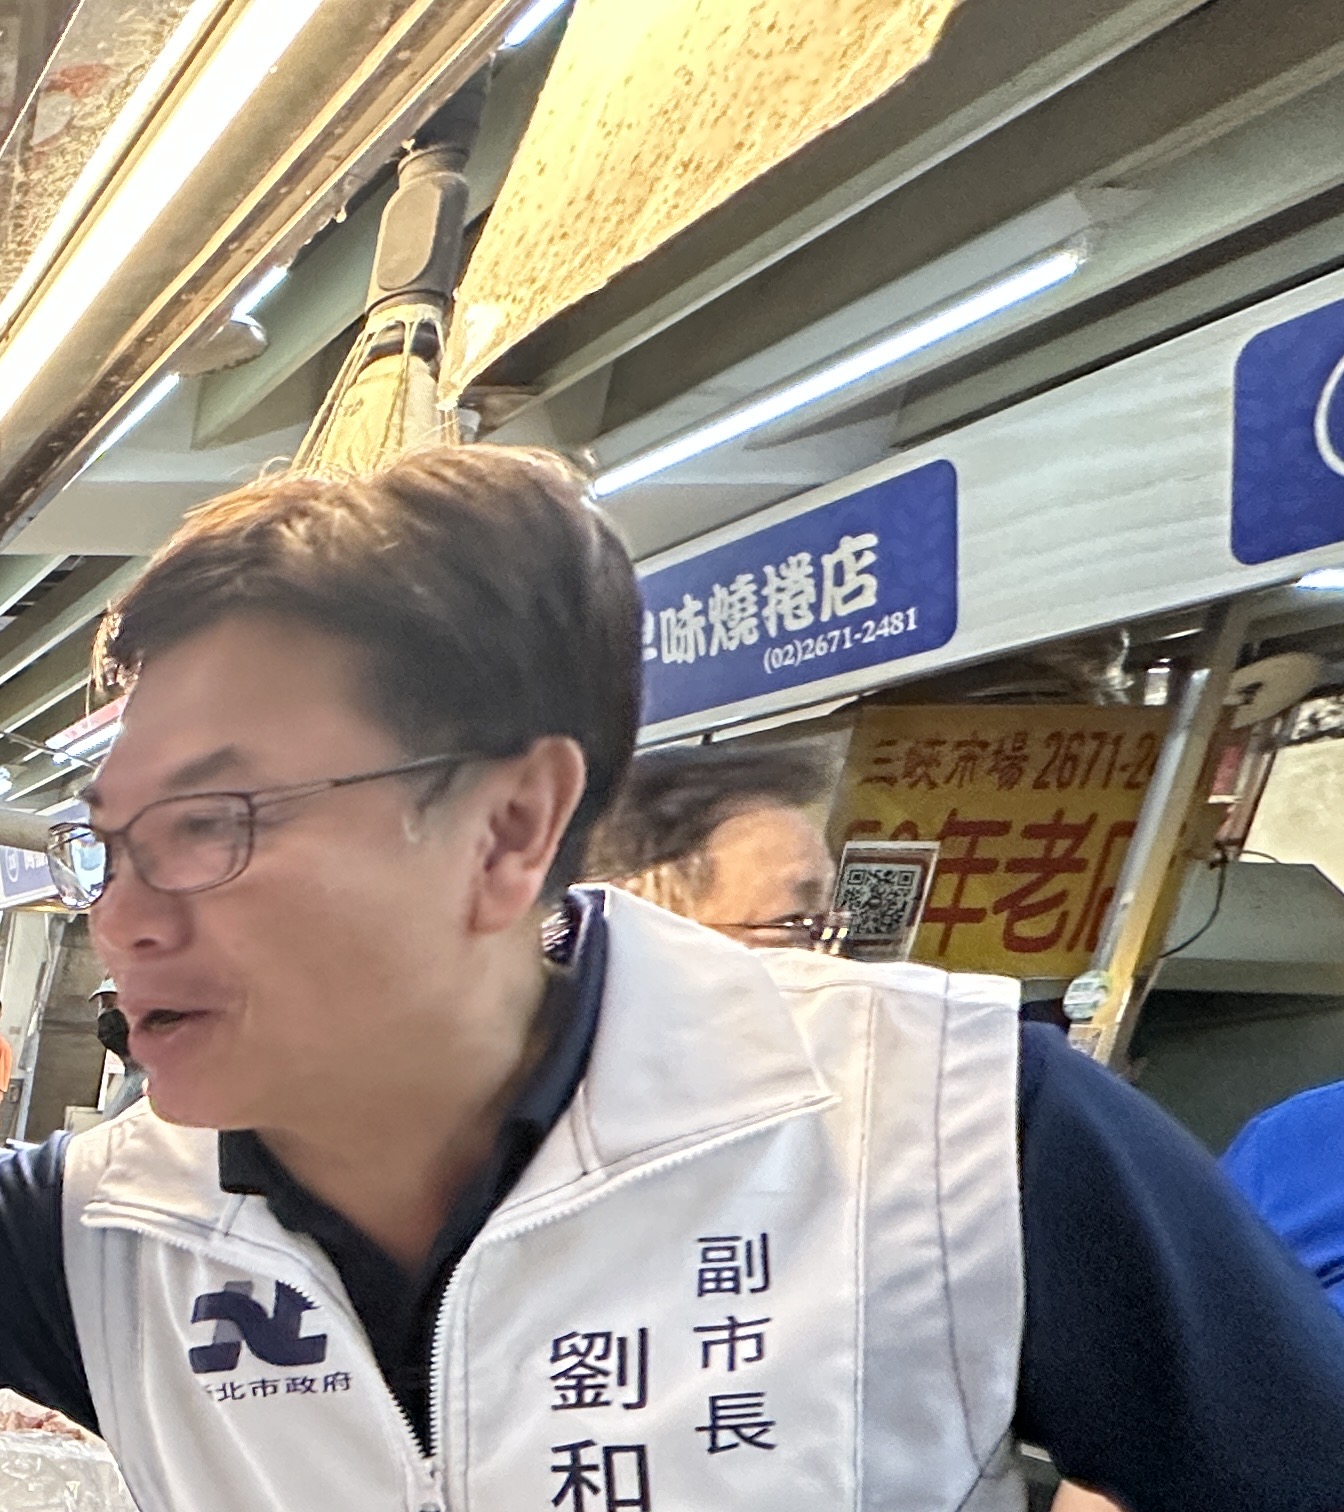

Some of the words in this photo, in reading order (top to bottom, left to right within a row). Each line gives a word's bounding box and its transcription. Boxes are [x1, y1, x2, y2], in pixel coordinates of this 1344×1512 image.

[642, 533, 879, 664] 味燒捲店
[763, 606, 918, 674] (02)2671-2481
[1031, 729, 1158, 791] 2671-2
[693, 1231, 778, 1455] 副市長
[205, 1370, 353, 1402] 北市政府
